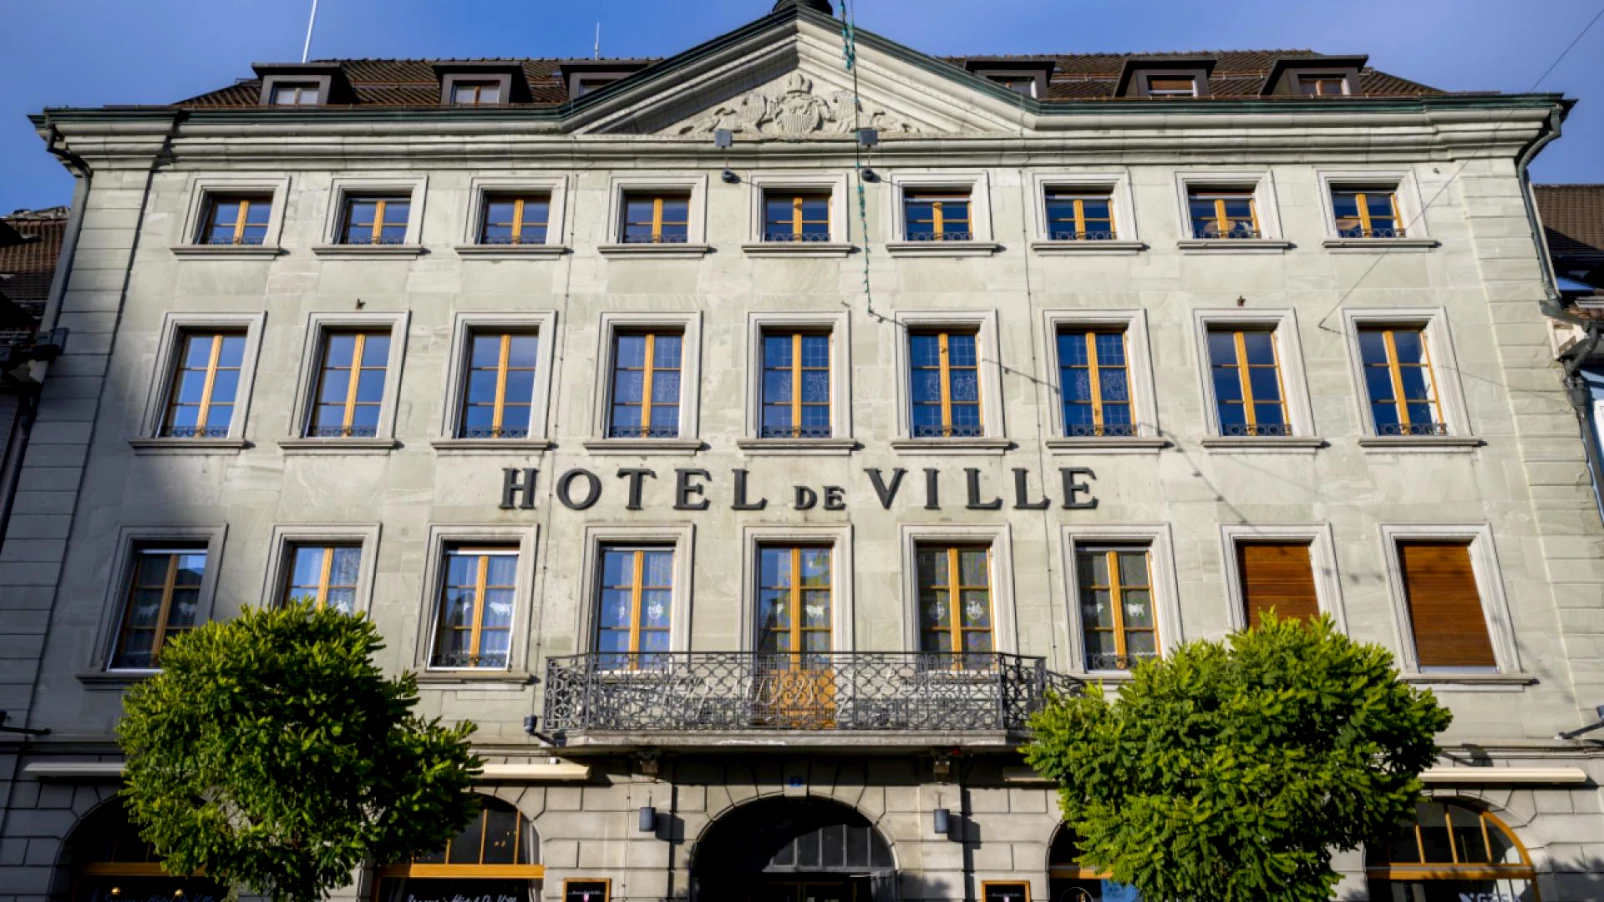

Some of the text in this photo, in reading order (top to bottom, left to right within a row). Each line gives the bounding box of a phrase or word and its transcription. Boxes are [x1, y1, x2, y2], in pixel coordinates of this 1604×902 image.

[498, 467, 1099, 511] HOTEL DE VILLE
